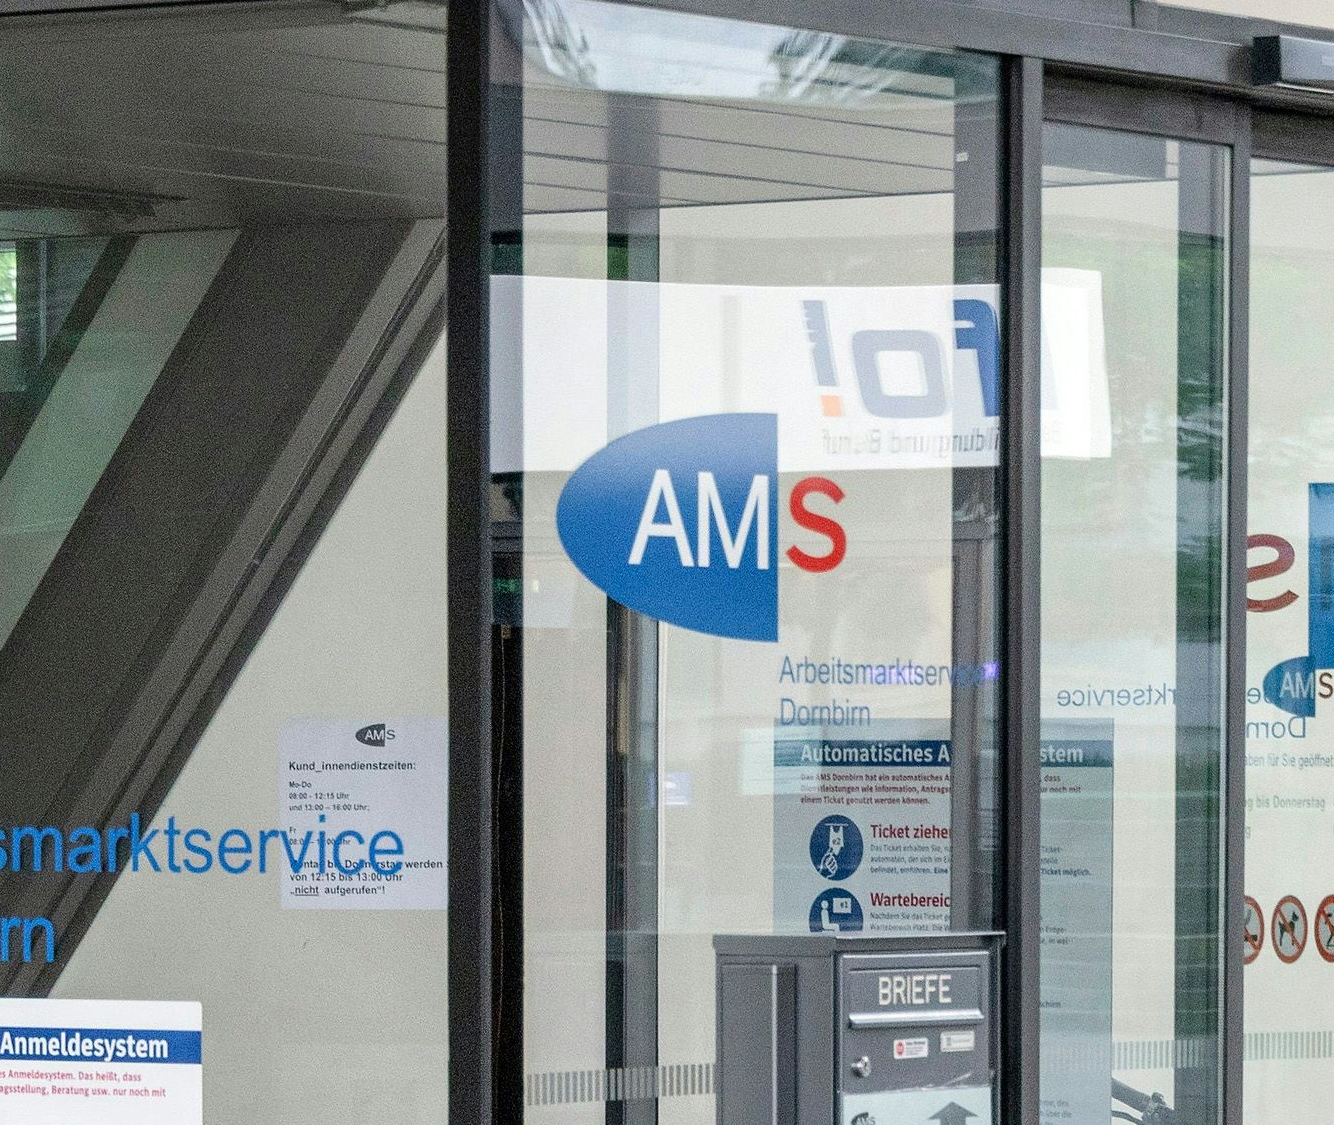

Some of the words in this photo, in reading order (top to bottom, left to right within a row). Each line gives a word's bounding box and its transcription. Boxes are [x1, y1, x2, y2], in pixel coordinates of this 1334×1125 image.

[628, 470, 846, 573] AMS
[1279, 672, 1334, 699] AMS
[781, 698, 870, 727] Dornbirn
[365, 730, 396, 741] AMS
[801, 745, 933, 763] Automatisches
[1267, 753, 1278, 766] für
[1282, 754, 1296, 766] Sie
[289, 761, 415, 772] Kund_innendienstzeiten:
[1257, 796, 1269, 808] bis
[1273, 796, 1325, 812] Donnerstag
[871, 825, 909, 838] Ticket
[914, 825, 950, 839] ziehe
[405, 859, 443, 868] werden
[311, 872, 336, 881] 12:15
[339, 872, 353, 881] bis
[357, 872, 382, 881] 13:00
[386, 872, 404, 881] Uhr
[870, 892, 950, 908] Wartebereic
[879, 974, 952, 1006] BRIEFE
[0, 1032, 168, 1062] Anmeldesystem
[8, 1069, 76, 1082] Anmeldesystem.
[78, 1072, 93, 1081] Das
[95, 1071, 119, 1083] heißt,
[123, 1072, 141, 1082] dass
[52, 1085, 89, 1097] Beratung
[92, 1088, 110, 1096] usw.
[113, 1089, 126, 1097] nur
[129, 1087, 149, 1097] noch
[152, 1088, 166, 1098] mit
